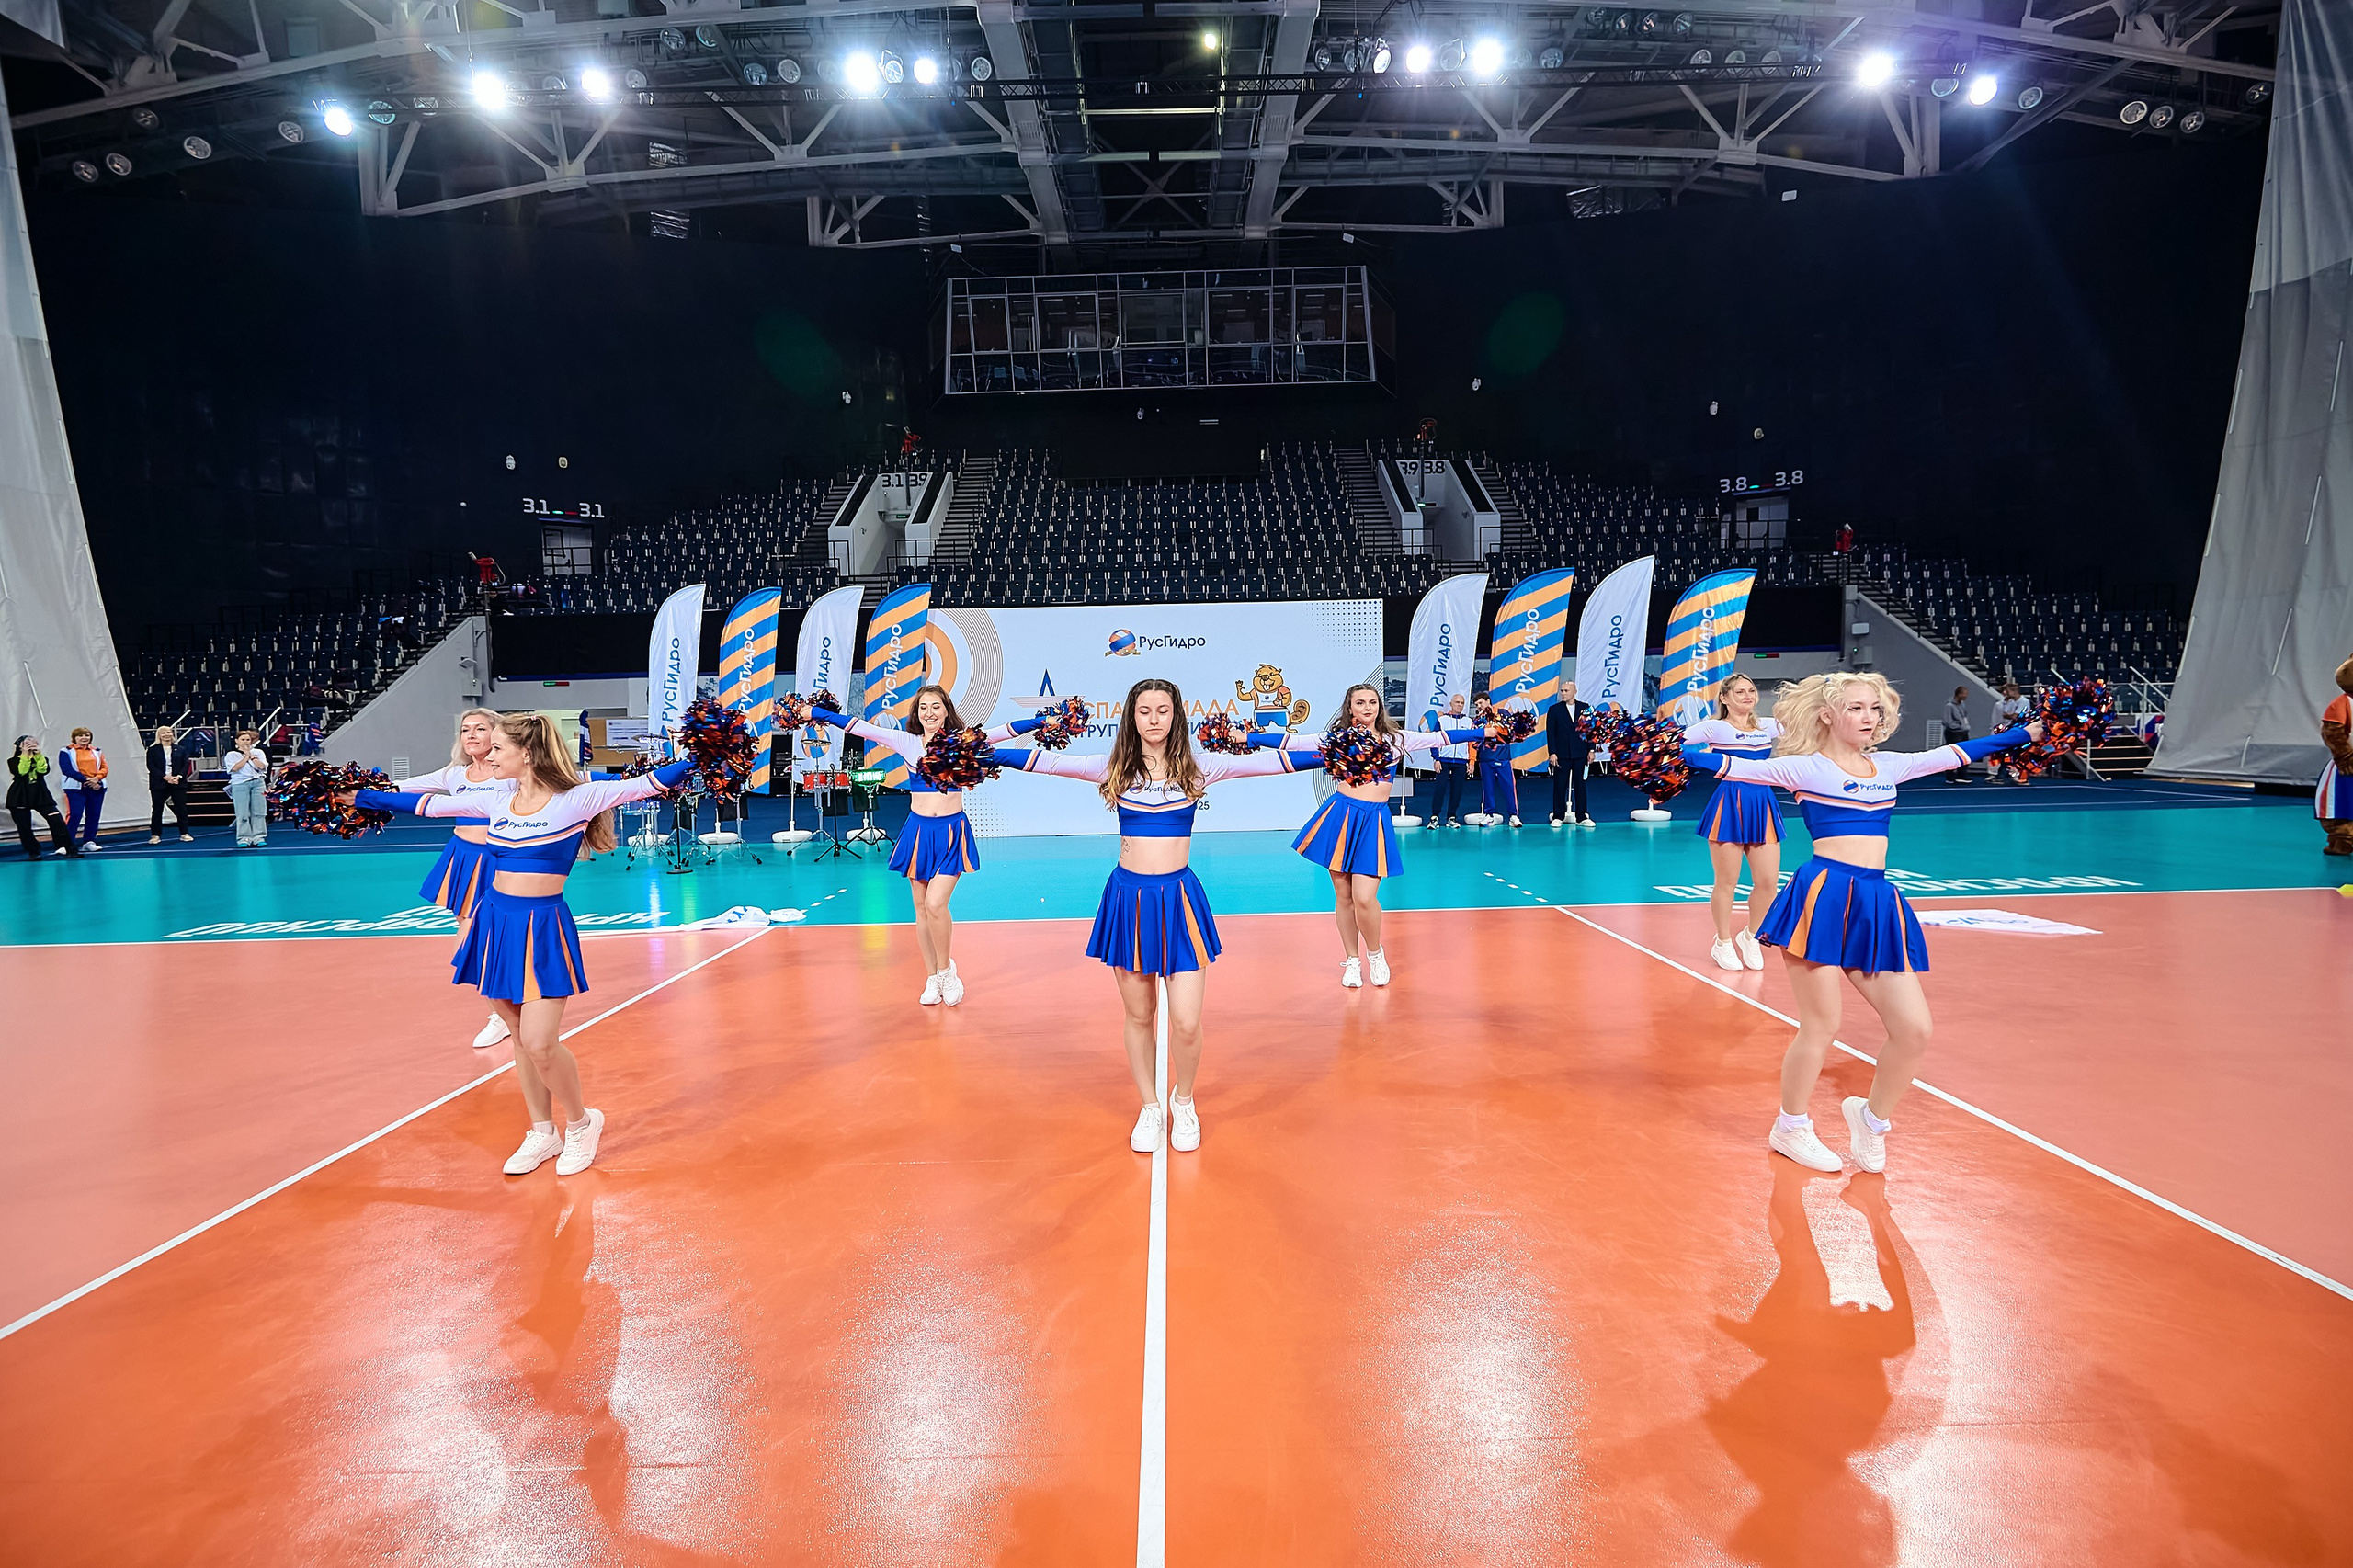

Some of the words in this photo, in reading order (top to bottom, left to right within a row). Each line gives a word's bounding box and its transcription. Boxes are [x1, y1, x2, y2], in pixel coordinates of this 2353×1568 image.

[882, 473, 904, 488] 3.1
[1424, 460, 1446, 474] 3.8
[1720, 476, 1747, 493] 3.8
[1775, 470, 1803, 486] 3.8
[522, 497, 551, 515] 3.1
[579, 502, 605, 518] 3.1
[738, 628, 756, 715] РусГидро
[813, 636, 832, 689] Гидро
[881, 623, 903, 710] РусГидро
[1139, 635, 1206, 651] РусГидро
[1430, 623, 1452, 708] РусГидро
[1515, 608, 1541, 694] РусГидро
[1601, 614, 1624, 699] РусГидро
[1686, 607, 1715, 693] РусГидро
[662, 637, 681, 722] РусГидро
[507, 821, 549, 830] РусГидро
